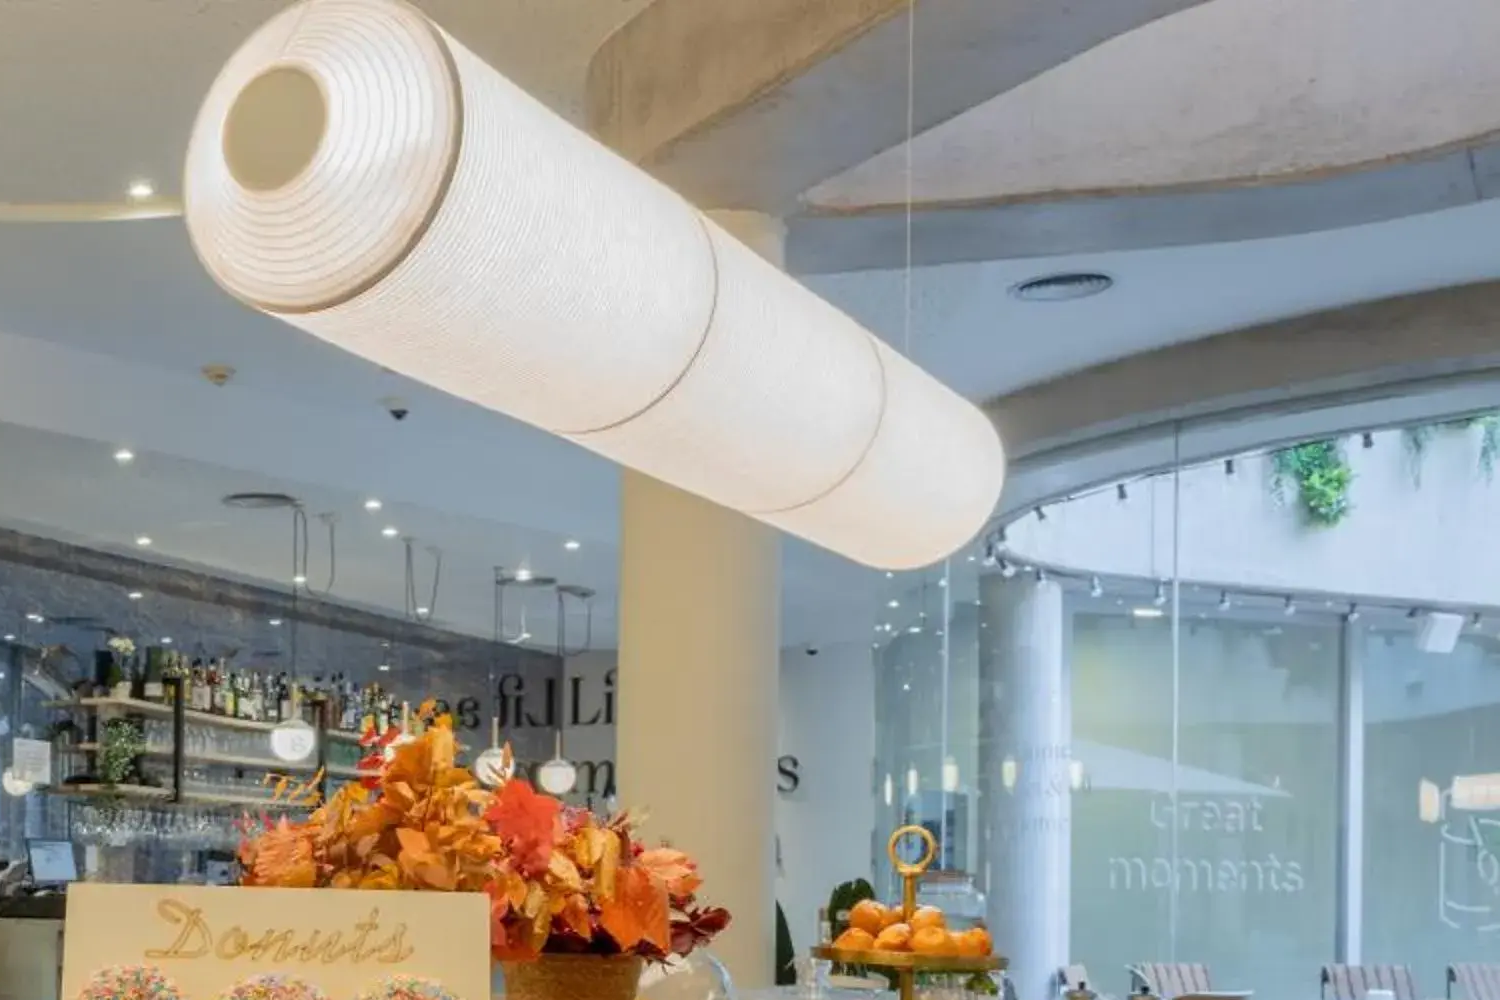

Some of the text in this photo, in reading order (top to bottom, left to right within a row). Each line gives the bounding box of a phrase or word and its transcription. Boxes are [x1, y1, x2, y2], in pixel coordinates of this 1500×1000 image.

[1150, 797, 1264, 832] Great
[1109, 853, 1304, 892] moments
[145, 899, 414, 964] Donuts
